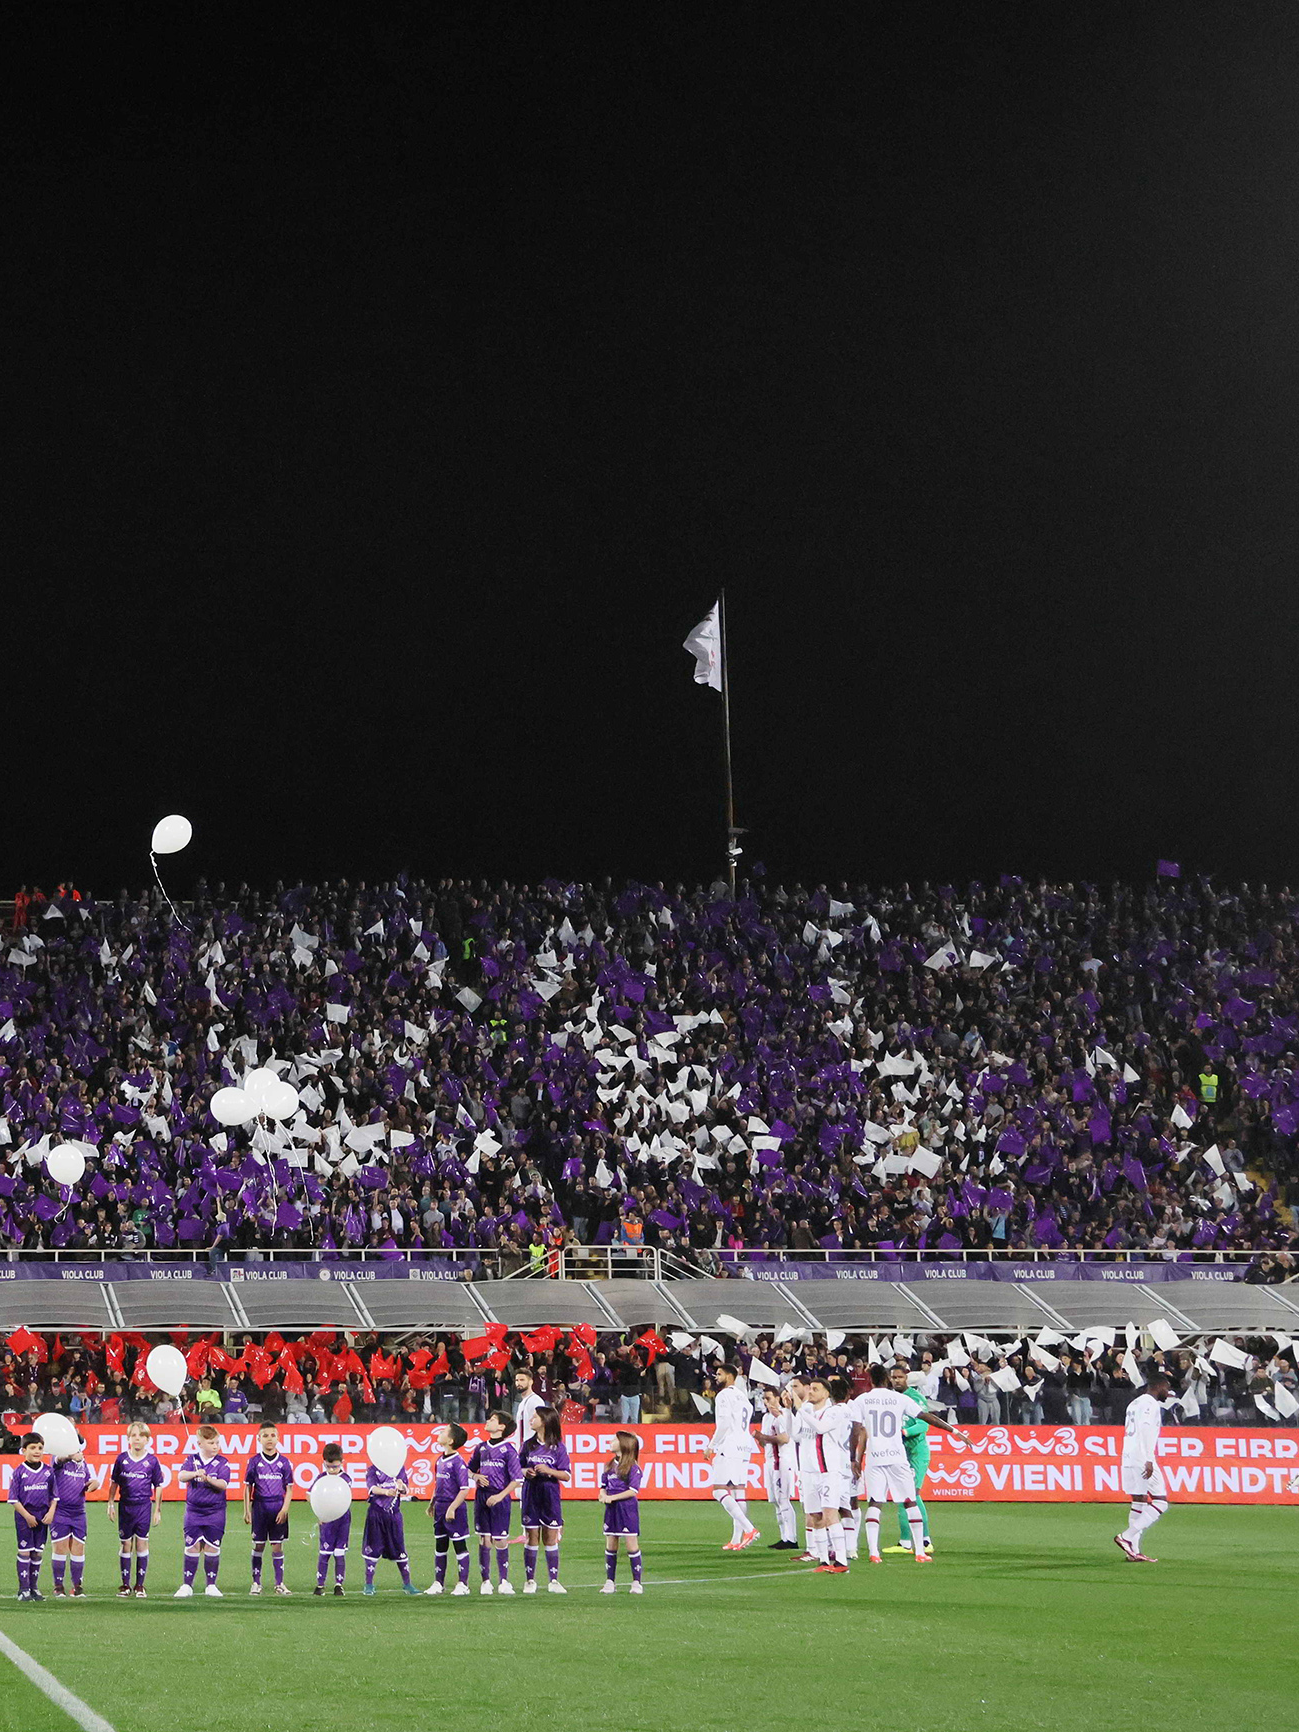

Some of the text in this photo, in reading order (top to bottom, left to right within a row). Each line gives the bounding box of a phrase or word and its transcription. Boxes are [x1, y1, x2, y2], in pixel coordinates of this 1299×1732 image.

[62, 1270, 104, 1279] VIOLA CLUB
[150, 1270, 192, 1279] VIOLA CLUB
[246, 1271, 288, 1280] VIOLA CLUB
[333, 1271, 376, 1280] VIOLA CLUB
[421, 1271, 443, 1280] VIOLA
[757, 1271, 799, 1281] VIOLA CLUB
[836, 1270, 878, 1279] VIOLA CLUB
[924, 1269, 967, 1278] VIOLA CLUB
[1013, 1269, 1056, 1279] VIOLA CLUB
[1102, 1270, 1144, 1280] VIOLA CLUB
[1191, 1271, 1234, 1281] VIOLA CLUB
[868, 1410, 897, 1438] 10
[870, 1449, 901, 1458] wefox
[985, 1464, 1083, 1491] VIENI
[932, 1488, 975, 1496] WINDTRE
